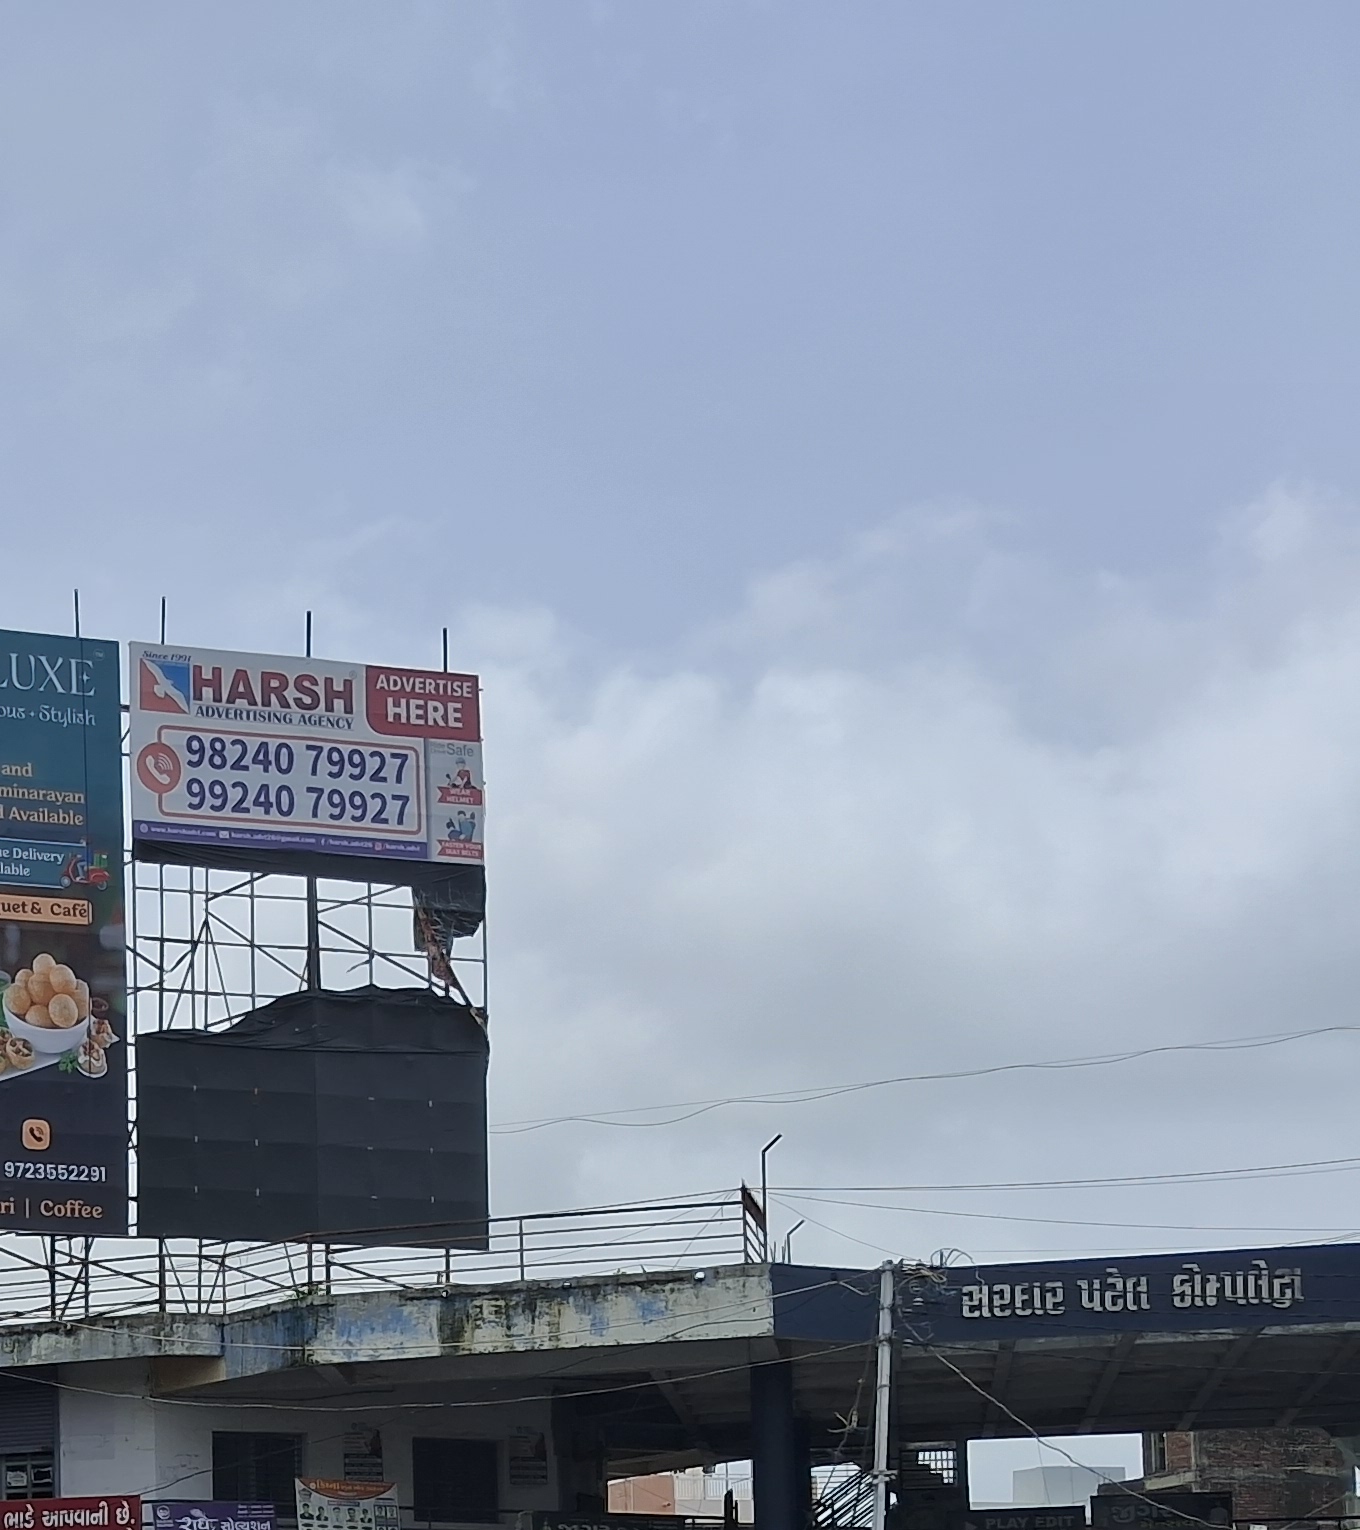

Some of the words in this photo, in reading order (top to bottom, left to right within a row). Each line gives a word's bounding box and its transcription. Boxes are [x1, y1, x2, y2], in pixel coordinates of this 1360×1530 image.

[142, 650, 168, 661] Since
[192, 665, 354, 715] HARSH
[376, 674, 473, 697] ADVERTISE
[39, 705, 96, 727] Stylish
[195, 705, 293, 725] ADVERTISING
[298, 714, 354, 730] AGENCY
[386, 697, 463, 728] HERE
[186, 735, 294, 775] 98240
[305, 744, 409, 784] 79927
[447, 743, 474, 757] Safe
[1, 762, 33, 778] and
[186, 778, 295, 817] 99240
[306, 786, 410, 826] 79927
[9, 806, 84, 826] Available
[12, 847, 64, 865] Delivery
[30, 901, 42, 914] &
[50, 902, 87, 918] Café
[4, 1161, 106, 1182] 9723552291
[40, 1200, 103, 1218] Coffee
[962, 1281, 1065, 1319] સરદાર
[1077, 1267, 1151, 1312] પટેલ
[4, 1504, 35, 1529] ભાડે
[42, 1501, 108, 1527] આપવાની
[985, 1517, 1026, 1529] PLAY
[1035, 1515, 1075, 1528] EDIT
